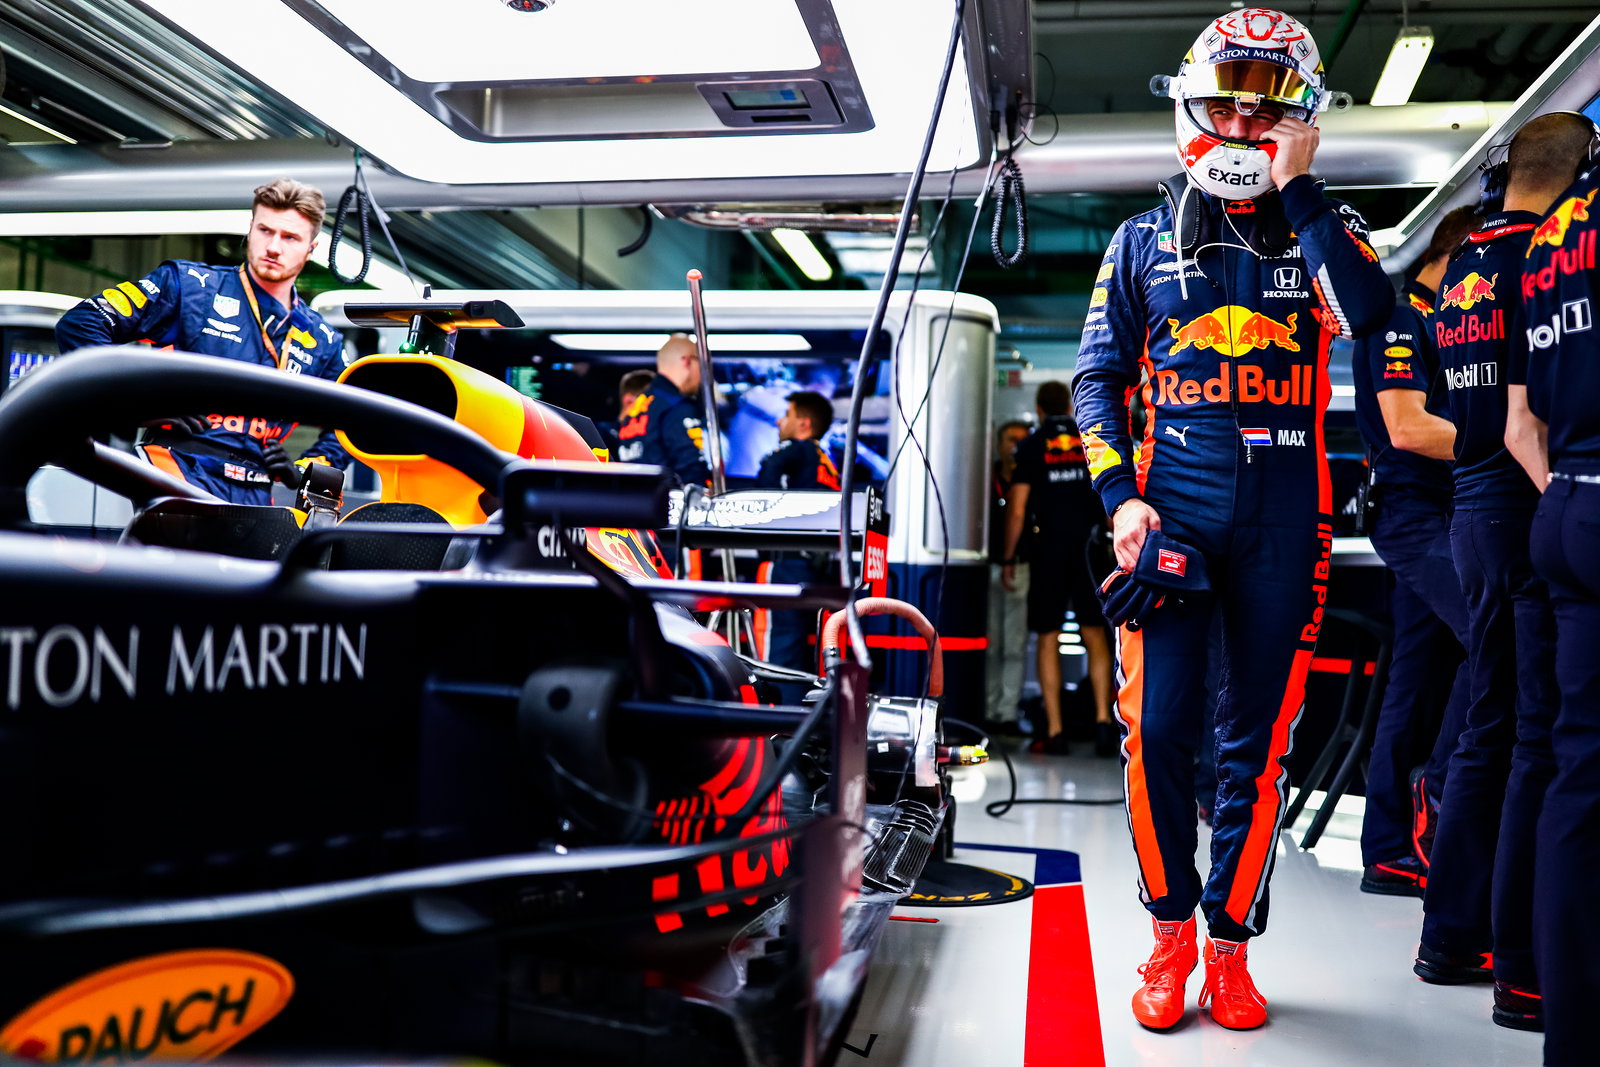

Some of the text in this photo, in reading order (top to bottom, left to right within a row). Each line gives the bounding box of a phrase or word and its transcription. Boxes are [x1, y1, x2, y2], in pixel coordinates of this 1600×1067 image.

[1214, 49, 1296, 67] ASTON MARTIN
[1208, 168, 1260, 185] exact
[1150, 275, 1172, 287] ASTON
[1436, 315, 1467, 349] Red
[1467, 309, 1505, 343] Bull
[1155, 362, 1312, 406] Red Bull
[1383, 371, 1413, 379] Red Bull
[1445, 364, 1478, 391] Mobil
[1277, 429, 1306, 447] MAX
[867, 545, 885, 580] ESSO
[1300, 522, 1333, 642] Red Bull
[165, 622, 367, 695] MARTIN
